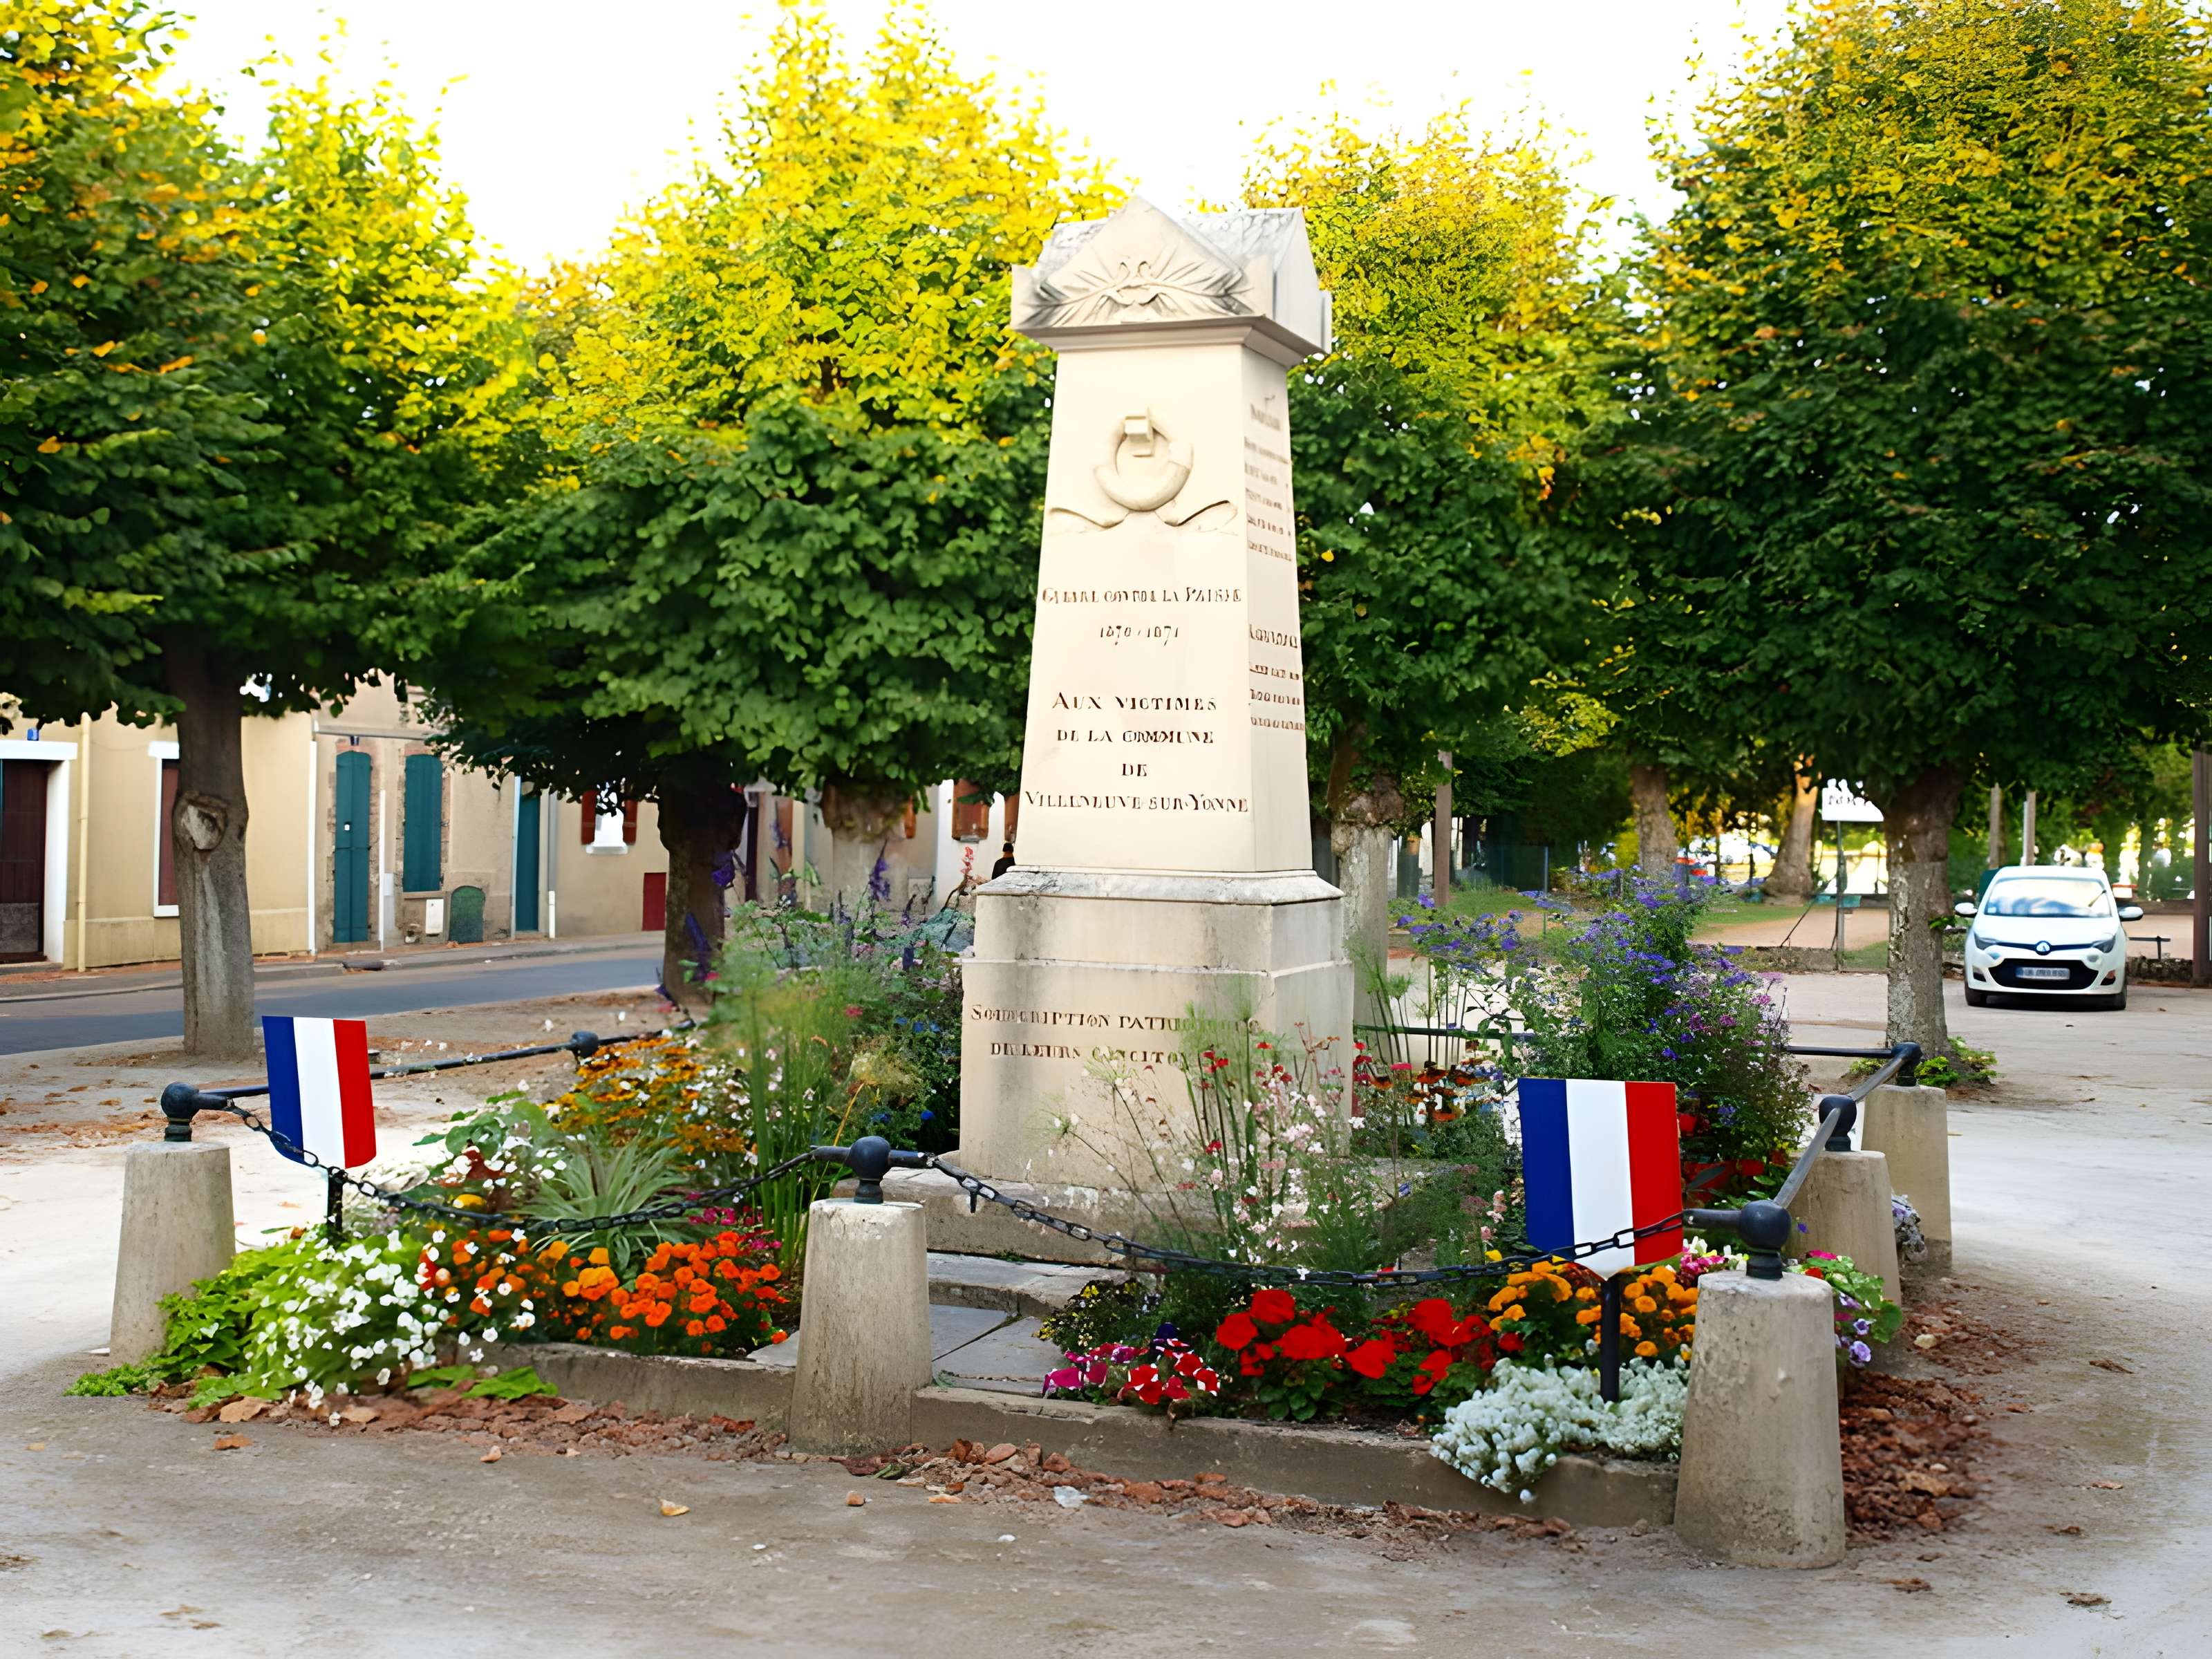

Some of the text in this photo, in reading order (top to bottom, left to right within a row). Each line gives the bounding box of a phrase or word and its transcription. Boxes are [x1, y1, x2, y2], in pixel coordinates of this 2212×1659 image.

[1051, 691, 1217, 711] AUX VICTIMES
[1087, 729, 1114, 743] LA
[1121, 762, 1147, 778] DE
